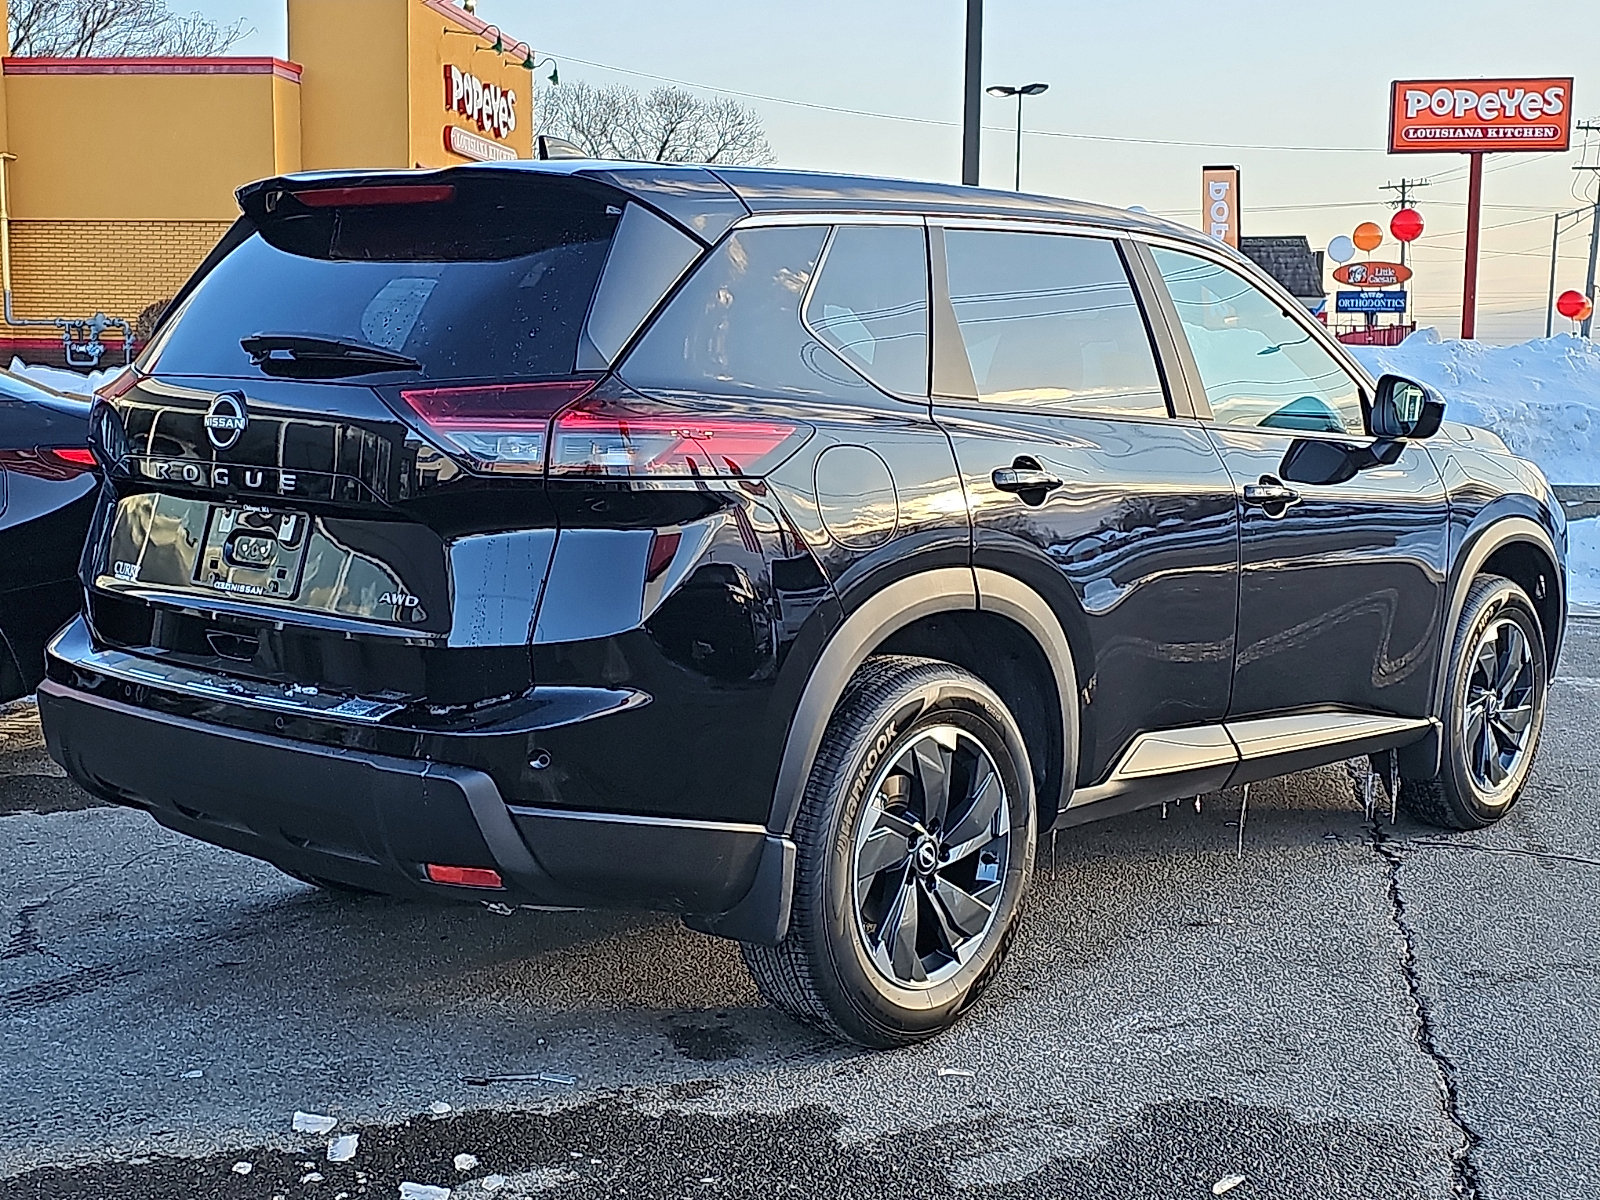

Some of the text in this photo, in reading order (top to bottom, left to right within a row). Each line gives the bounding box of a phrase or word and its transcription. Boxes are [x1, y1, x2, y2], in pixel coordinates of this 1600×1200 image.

[1407, 127, 1556, 139] LOUISIANA KITCHEN
[1374, 267, 1396, 276] Little
[1338, 298, 1405, 308] ORTHODONTICS
[205, 415, 245, 430] NISSAN
[156, 461, 297, 491] ROGUE
[230, 583, 264, 596] NISSAN
[379, 592, 420, 607] AWD
